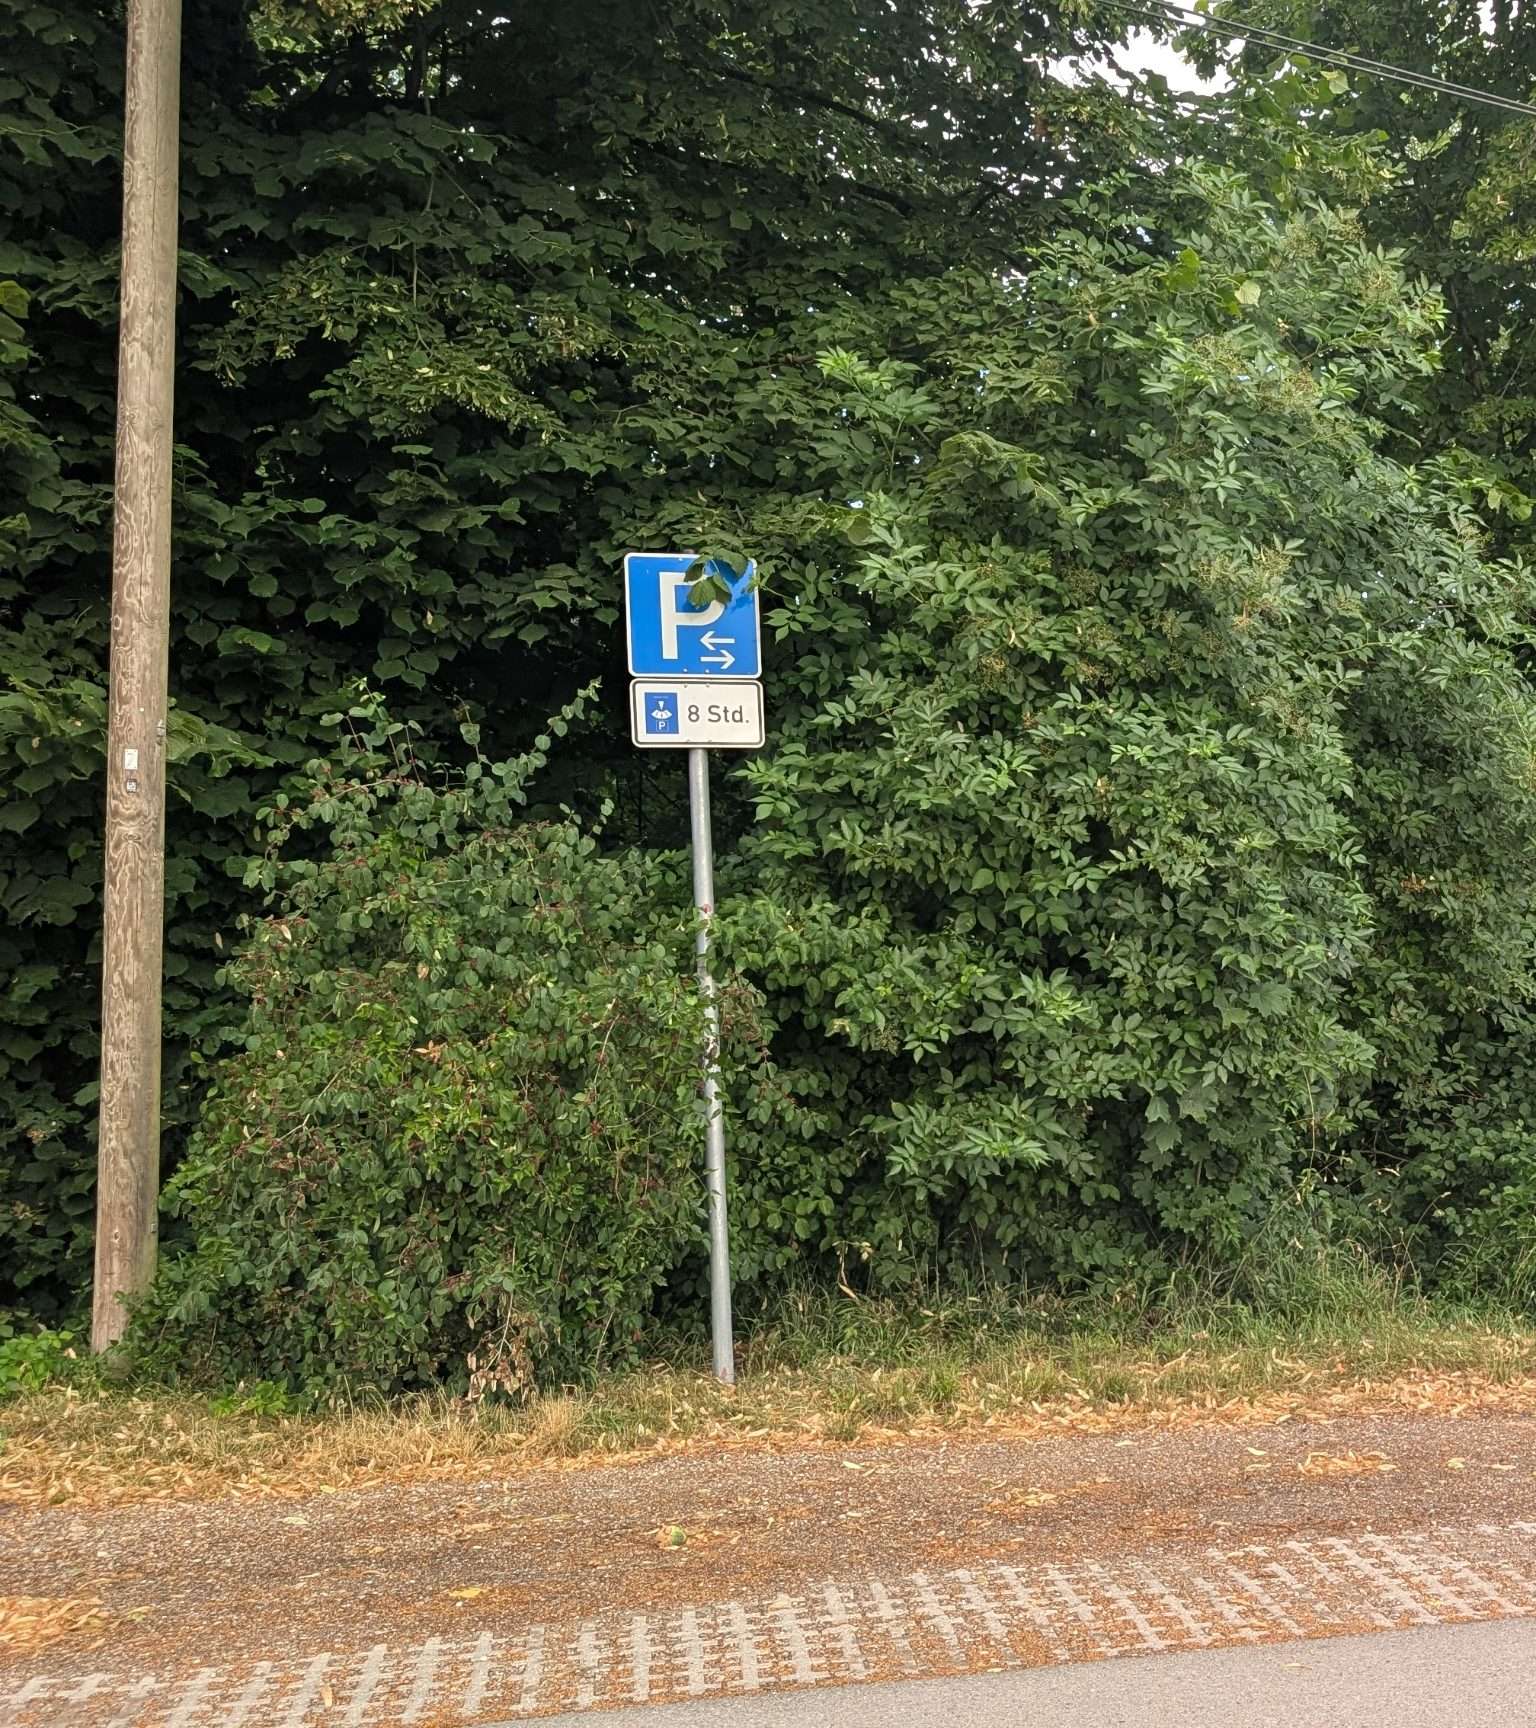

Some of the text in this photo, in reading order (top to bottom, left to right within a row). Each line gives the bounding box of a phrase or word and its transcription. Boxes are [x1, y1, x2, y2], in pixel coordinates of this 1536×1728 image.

[659, 572, 726, 660] P
[688, 704, 750, 723] 8 Std.
[658, 721, 666, 730] P
